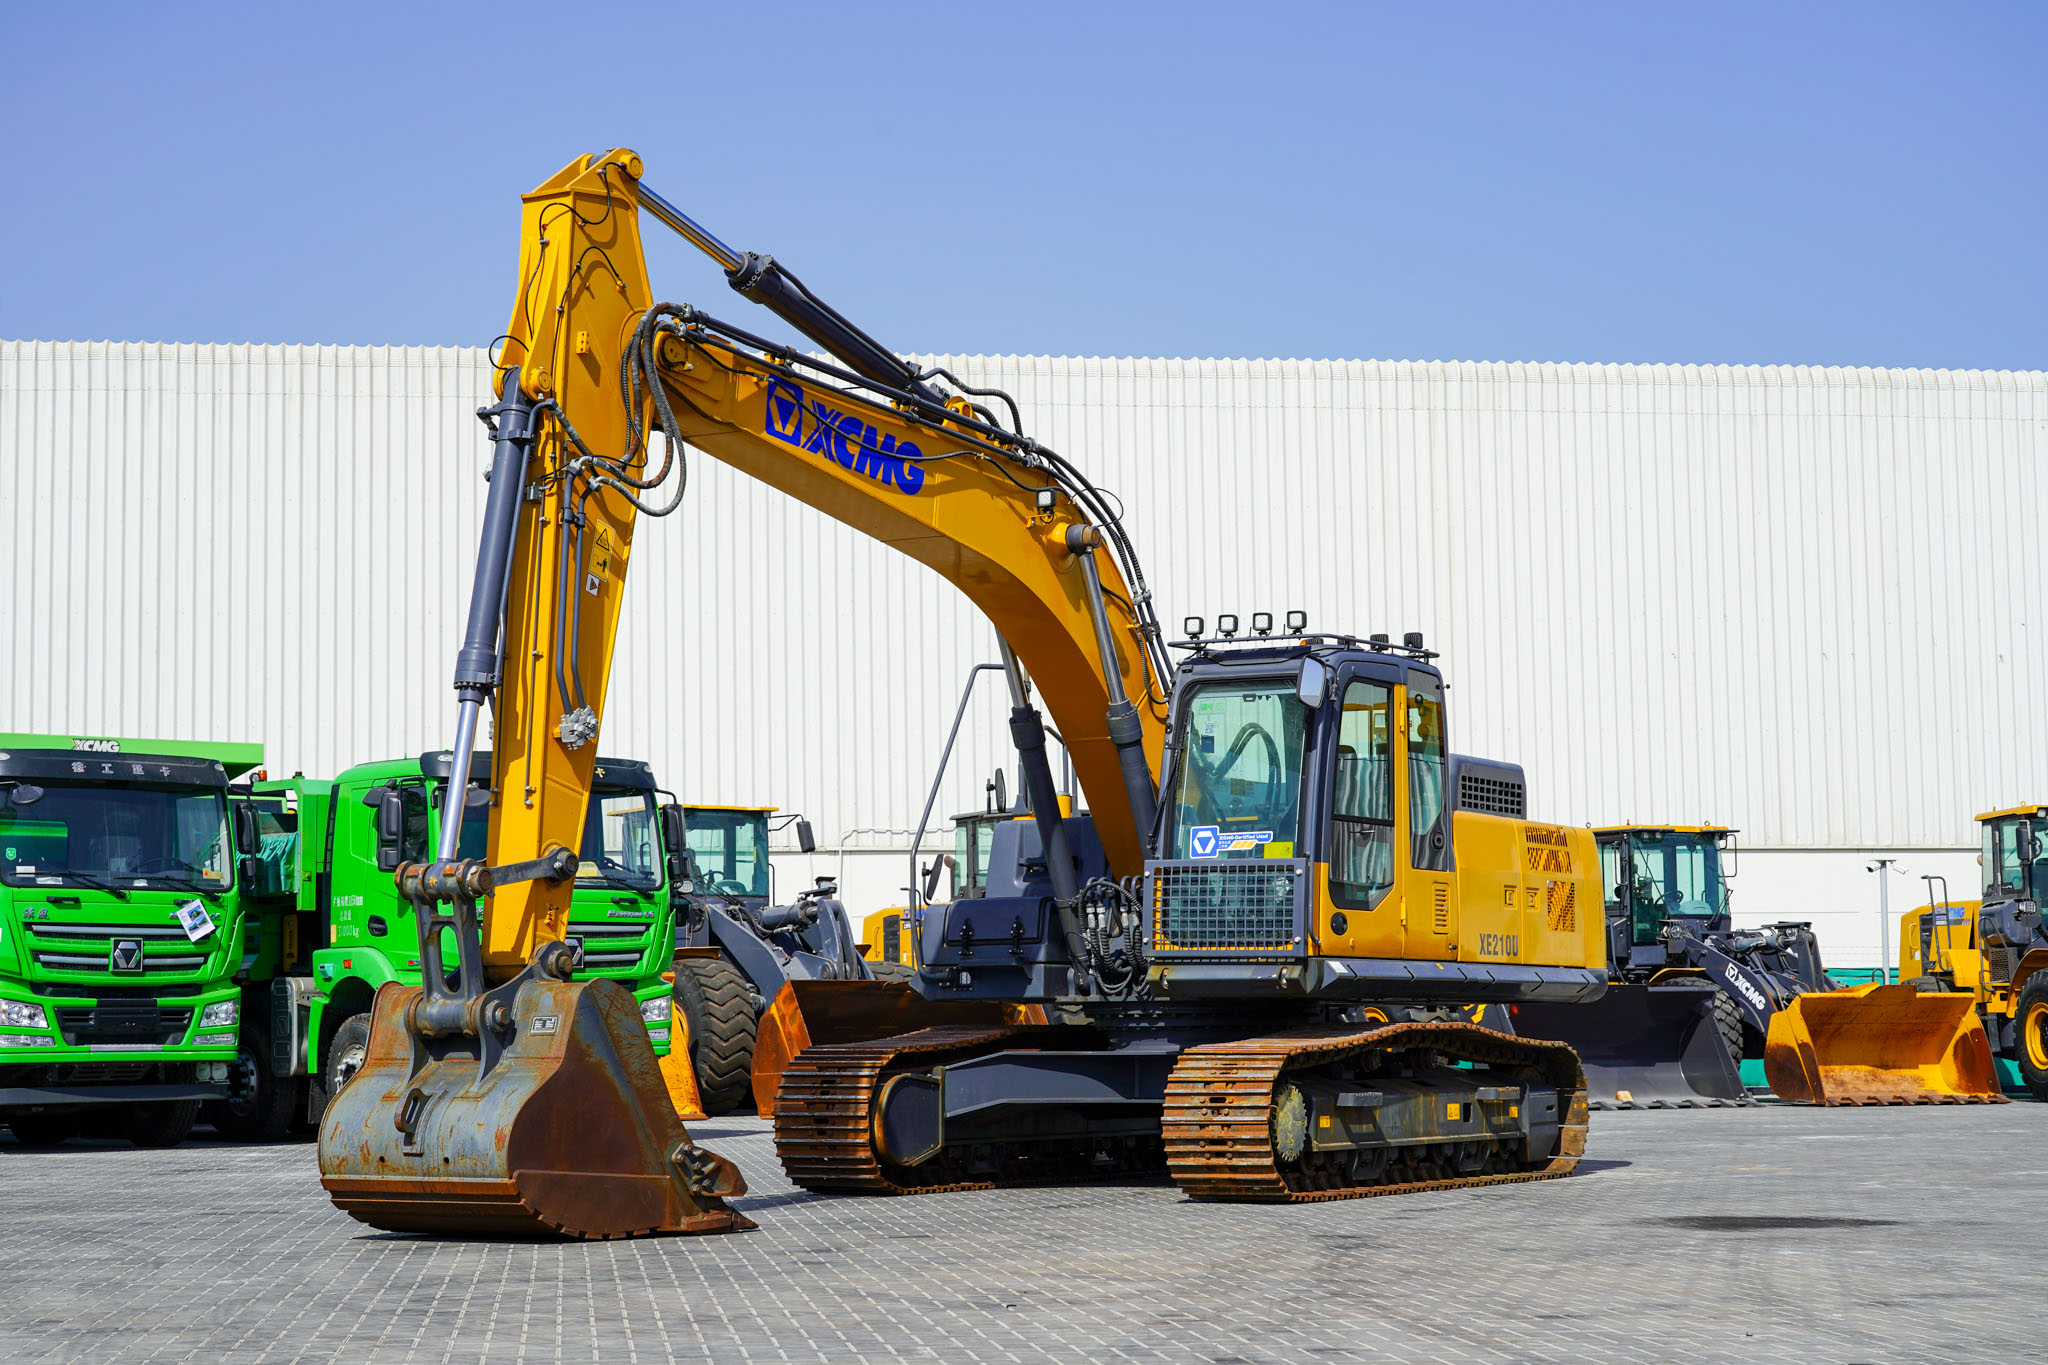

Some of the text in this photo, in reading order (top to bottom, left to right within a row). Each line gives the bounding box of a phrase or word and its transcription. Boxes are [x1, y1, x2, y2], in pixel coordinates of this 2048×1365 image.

[801, 400, 925, 496] XCMG
[72, 739, 120, 753] XCMG
[1944, 906, 1965, 919] CMG
[1479, 934, 1519, 957] XE210U
[1734, 973, 1766, 1010] XCMG
